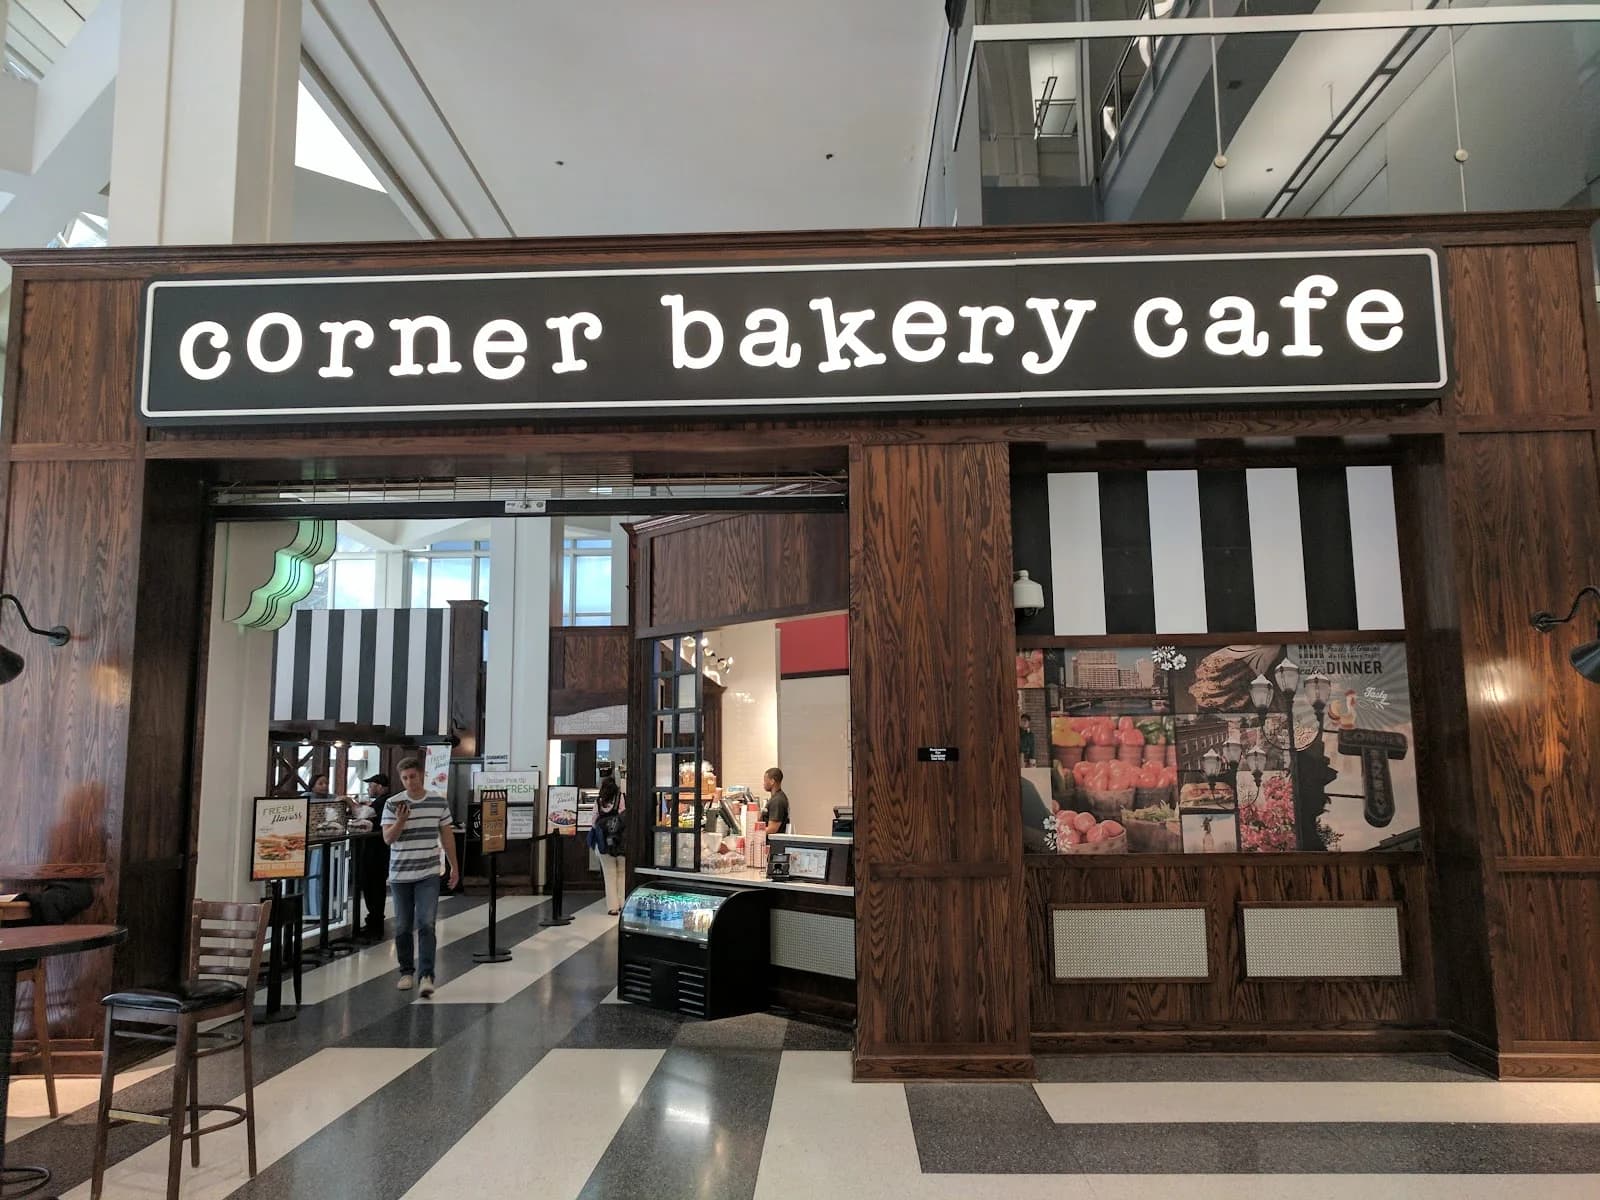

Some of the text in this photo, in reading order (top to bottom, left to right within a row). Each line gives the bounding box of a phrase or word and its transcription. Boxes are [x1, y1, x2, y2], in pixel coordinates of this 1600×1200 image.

[180, 274, 1404, 381] corner bakery cafe
[1327, 660, 1383, 675] DINNER
[505, 784, 535, 794] FRESH
[263, 804, 295, 817] FRESH
